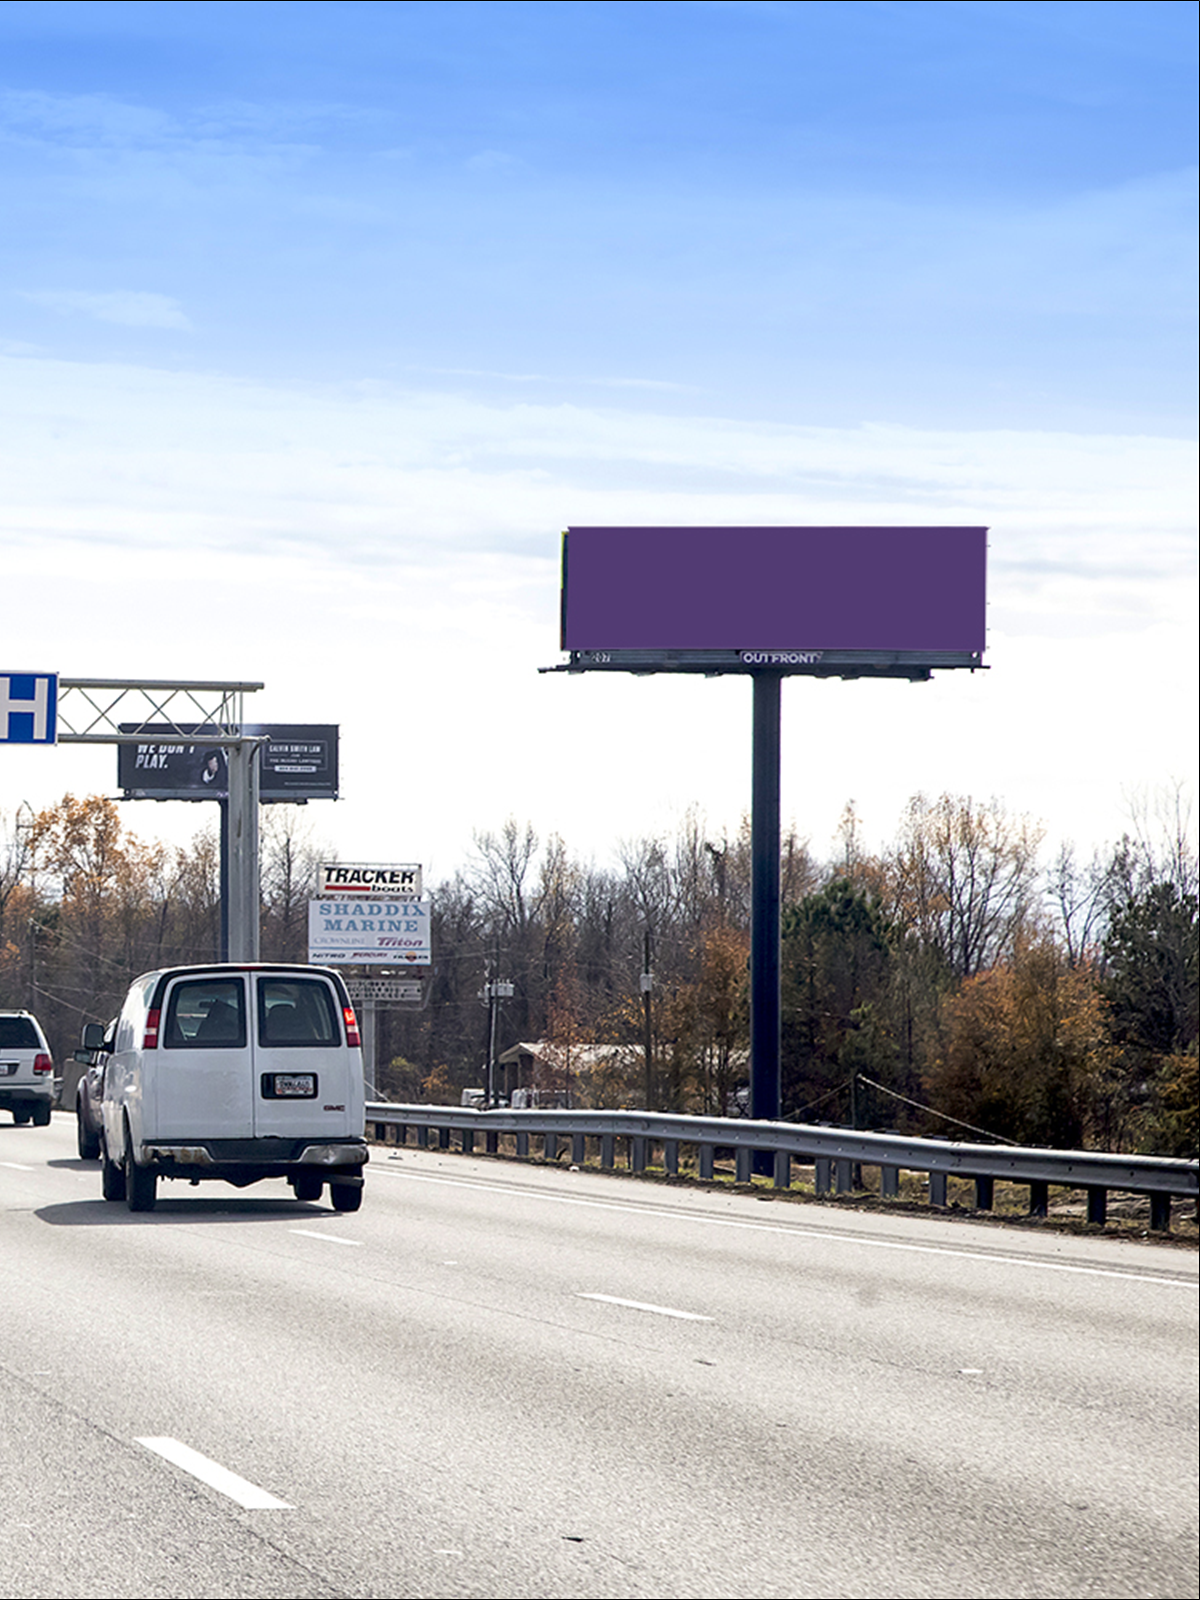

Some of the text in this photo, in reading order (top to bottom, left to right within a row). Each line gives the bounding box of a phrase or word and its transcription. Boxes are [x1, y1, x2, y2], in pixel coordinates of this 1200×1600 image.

[135, 754, 169, 769] PLAY.
[324, 867, 415, 884] TRACKER
[372, 884, 414, 893] boats
[319, 903, 426, 917] SHADDIX
[324, 919, 418, 932] MARINE
[377, 936, 423, 947] Triton
[323, 1104, 346, 1112] GMC
